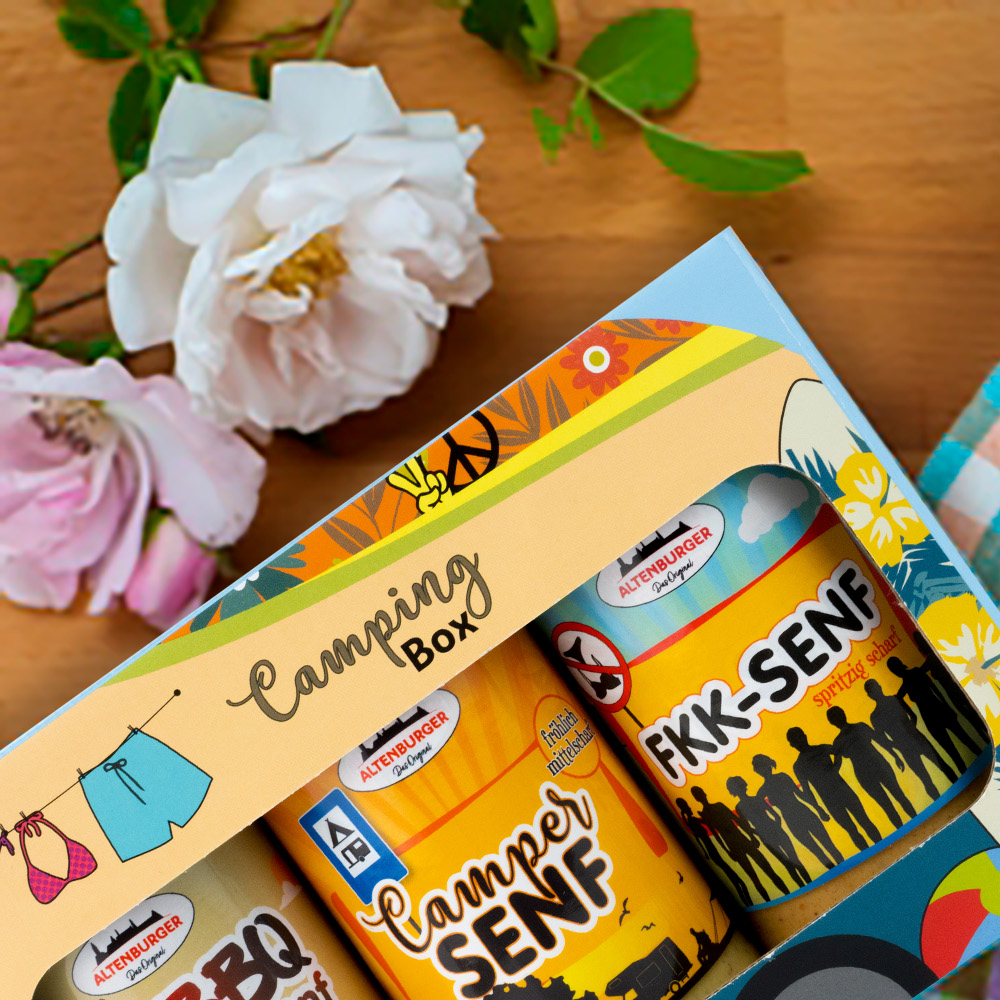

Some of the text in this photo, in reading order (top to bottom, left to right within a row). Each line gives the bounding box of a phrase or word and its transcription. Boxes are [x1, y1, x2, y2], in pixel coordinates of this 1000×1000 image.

[618, 526, 714, 599] ALTENBURGER
[651, 557, 694, 594] Das Original
[226, 551, 493, 723] Camping
[400, 610, 480, 673] Box
[645, 567, 874, 780] FKK-SENF
[812, 624, 902, 708] spritzig scharf
[359, 711, 450, 784] ALTENBURGER
[391, 742, 433, 778] Das Original
[539, 706, 580, 749] fröhlich
[362, 786, 594, 954] Camper
[93, 914, 184, 987] ALTENBURGER
[436, 836, 607, 1000] SENF
[125, 945, 167, 982] Das Original
